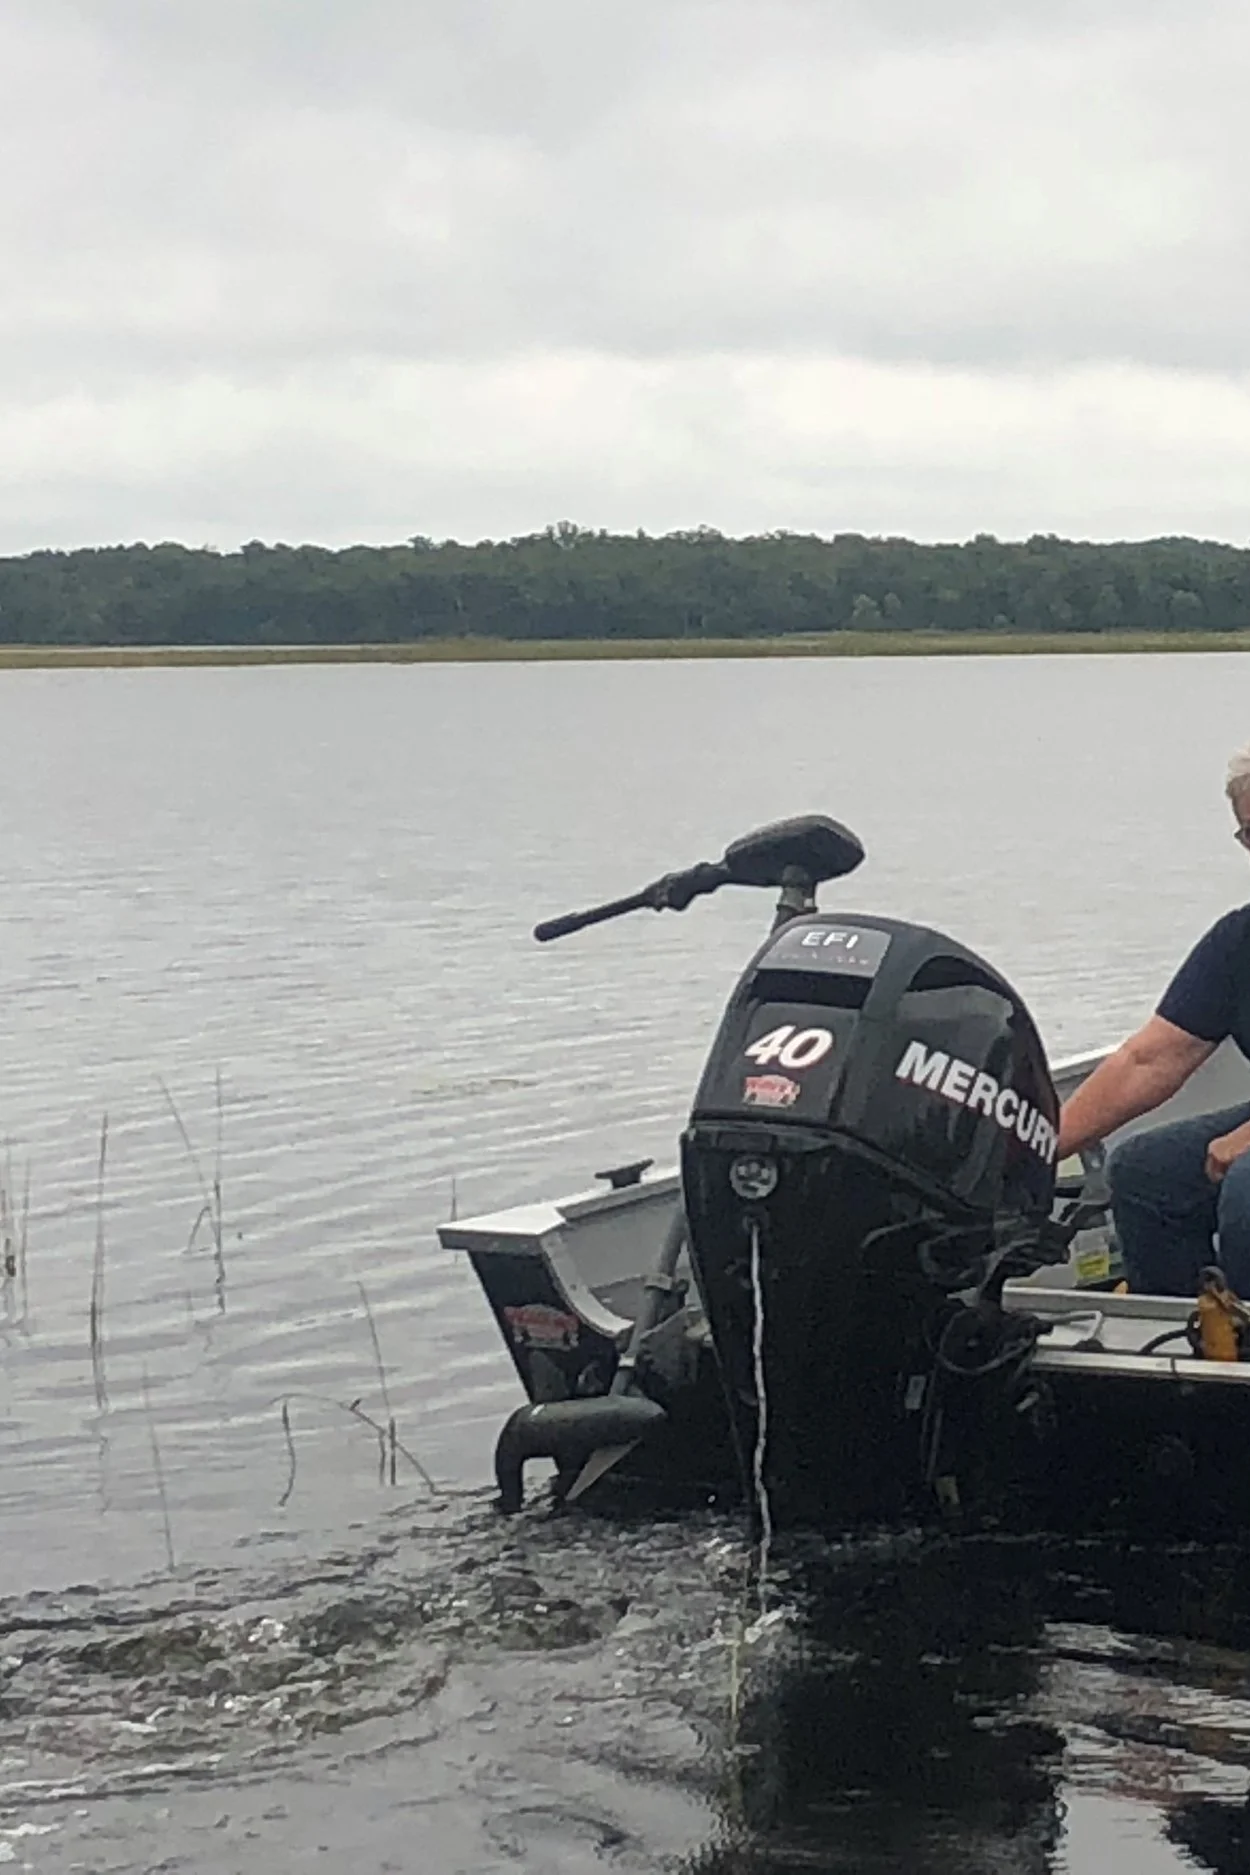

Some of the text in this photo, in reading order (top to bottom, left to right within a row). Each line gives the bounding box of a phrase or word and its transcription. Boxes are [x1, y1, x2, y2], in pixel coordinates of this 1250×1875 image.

[801, 930, 859, 949] EFI
[744, 1025, 833, 1069] 40
[895, 1040, 1060, 1165] MERCURY
